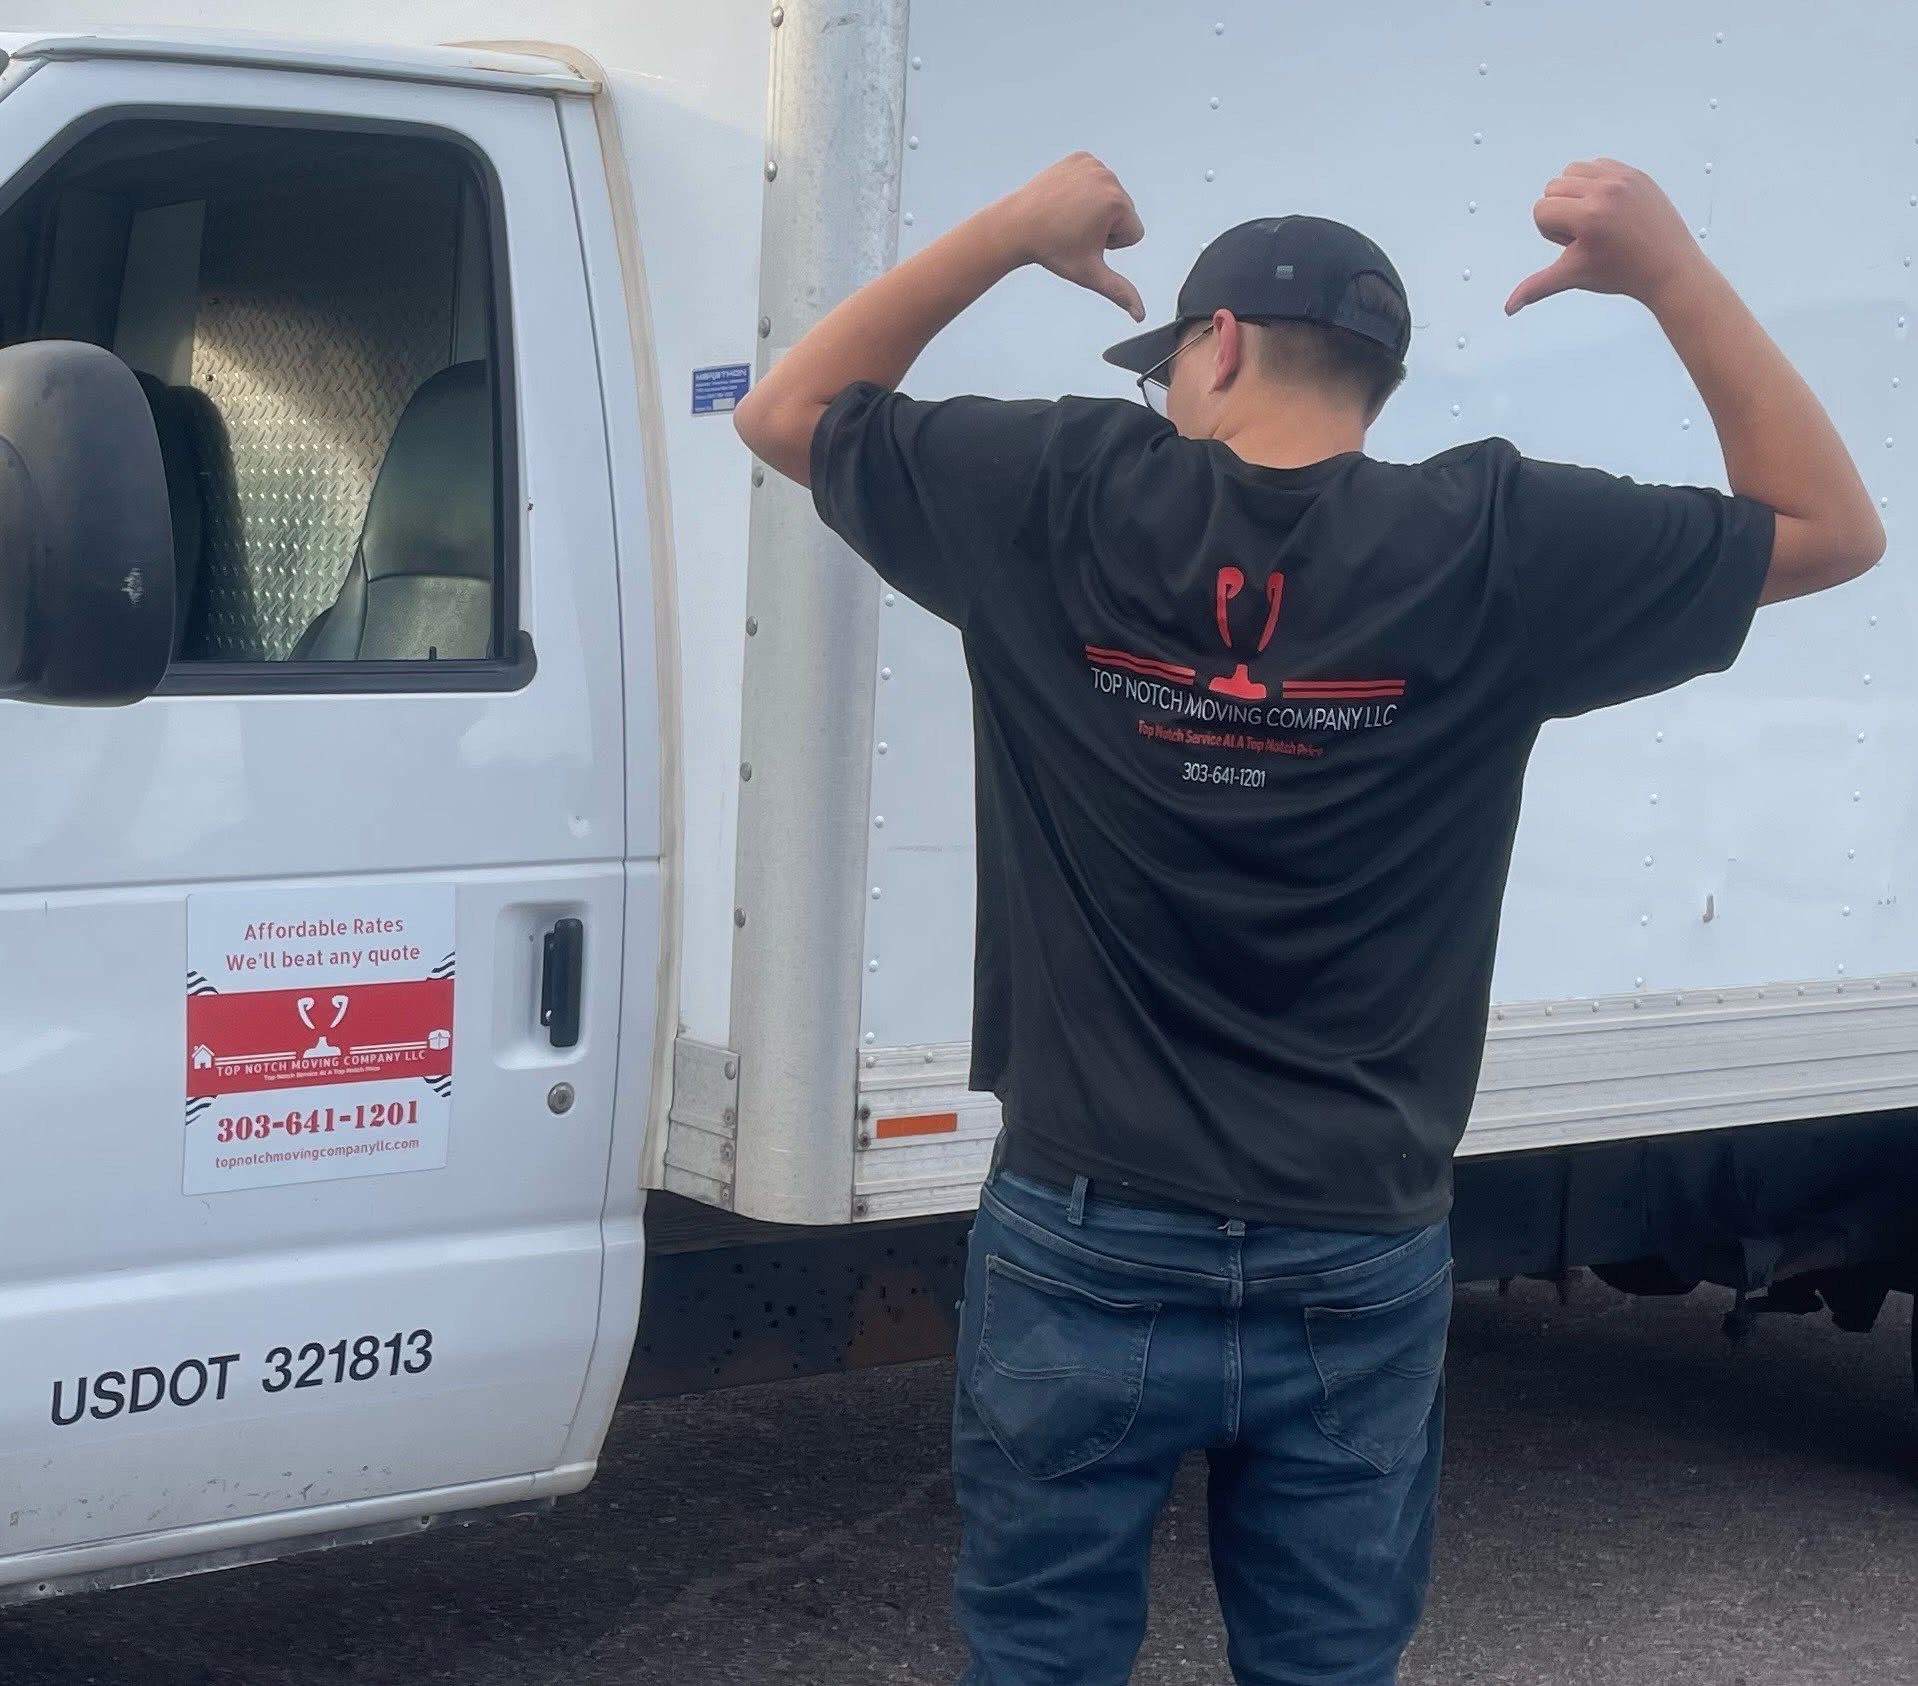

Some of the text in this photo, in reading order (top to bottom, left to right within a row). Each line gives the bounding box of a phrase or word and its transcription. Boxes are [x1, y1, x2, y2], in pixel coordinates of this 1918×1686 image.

[1091, 667, 1398, 731] TOP NOTCH MOVING COMPANY LLC
[1182, 761, 1266, 788] 303-641-1201
[244, 917, 404, 941] Affordable Rates
[226, 945, 421, 971] We'll beat any quote
[216, 1050, 426, 1077] TOP NOTCH MOVING COMPANY LLC
[217, 1100, 417, 1143] 303-641-1201
[216, 1138, 420, 1169] topnotchmovingcompanyllc.com
[51, 1328, 433, 1426] USDOT 321813
